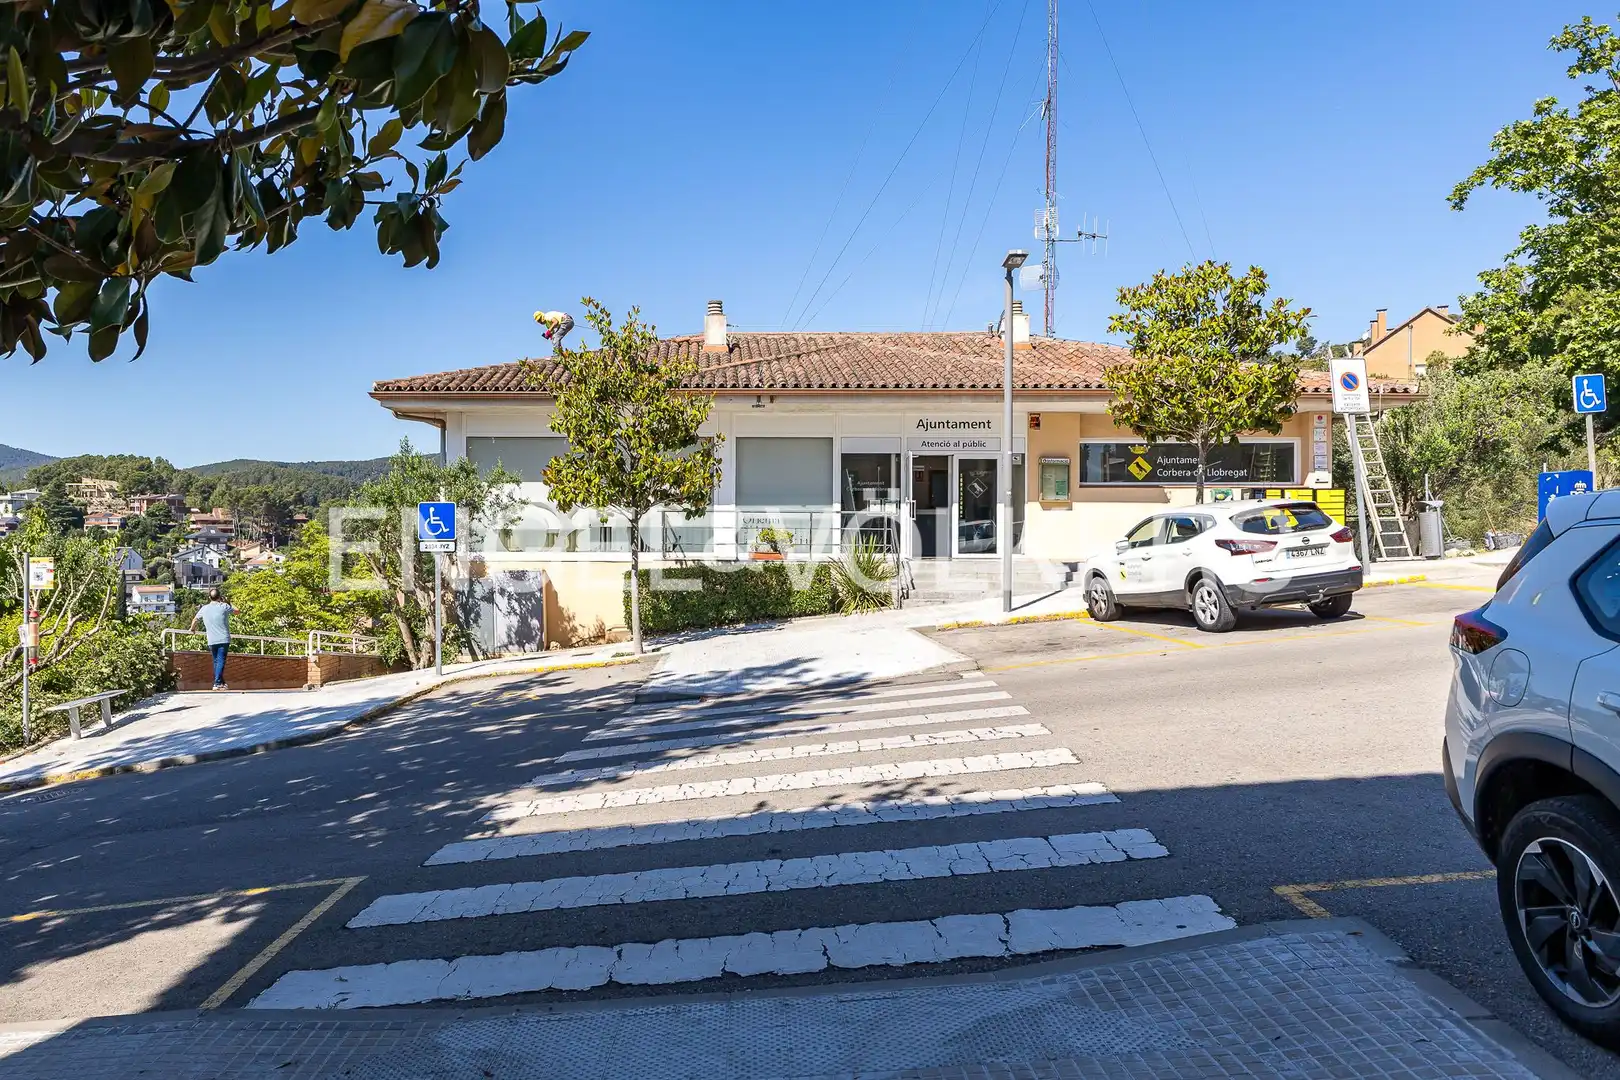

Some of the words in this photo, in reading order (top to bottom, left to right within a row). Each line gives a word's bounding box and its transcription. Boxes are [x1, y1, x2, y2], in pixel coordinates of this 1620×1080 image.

[916, 419, 992, 431] Ajuntament
[920, 440, 951, 448] Atenció
[952, 440, 960, 448] al
[962, 440, 986, 449] públic
[1156, 456, 1200, 466] Ajuntame
[1156, 467, 1191, 477] Corbera
[1206, 467, 1248, 479] Llobregat
